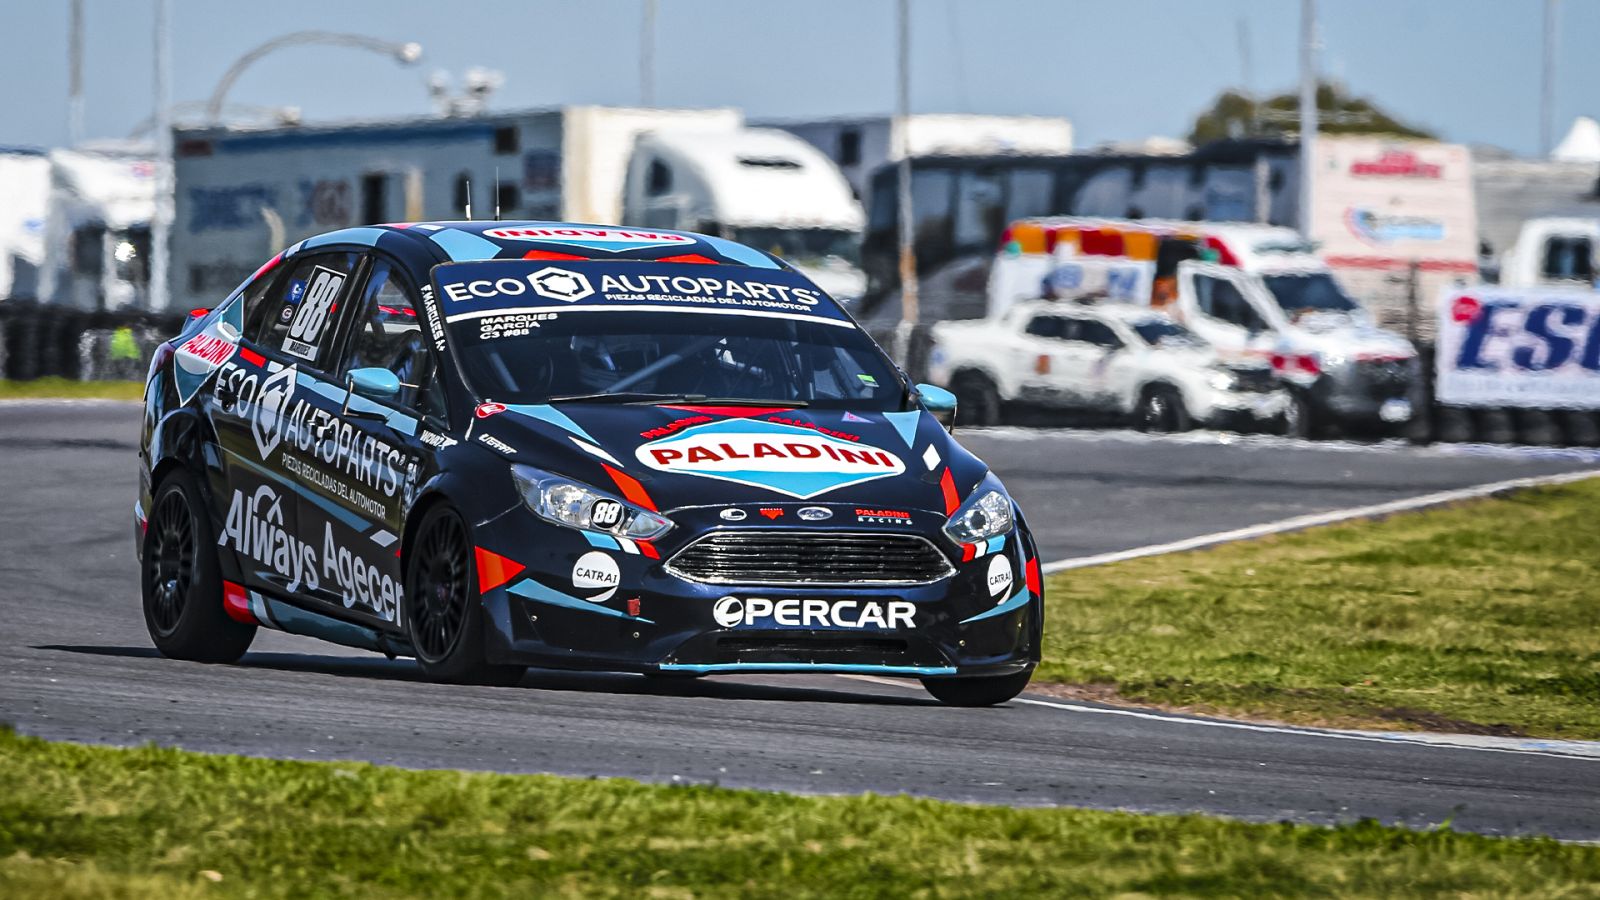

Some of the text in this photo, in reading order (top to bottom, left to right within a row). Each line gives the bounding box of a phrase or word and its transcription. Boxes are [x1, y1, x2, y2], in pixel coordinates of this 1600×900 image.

[493, 229, 686, 242] PALADINI
[443, 278, 526, 302] ECO
[290, 271, 343, 343] 88
[647, 294, 717, 304] RECICLADAS
[719, 297, 741, 305] DEL
[742, 299, 812, 312] AUTOMOTOR
[480, 313, 558, 325] MARQUES
[480, 331, 500, 340] C3
[183, 334, 235, 365] PALADINI
[768, 416, 861, 442] PALADINI
[650, 442, 895, 467] PALADINI
[336, 482, 349, 500] DEL
[348, 488, 386, 520] AUTOMOTOR
[592, 502, 621, 524] 88
[855, 509, 911, 519] PALADINI
[857, 516, 913, 525] RACING
[217, 488, 320, 593] Always
[576, 568, 618, 584] CATRAI
[745, 598, 917, 629] PERCAR
